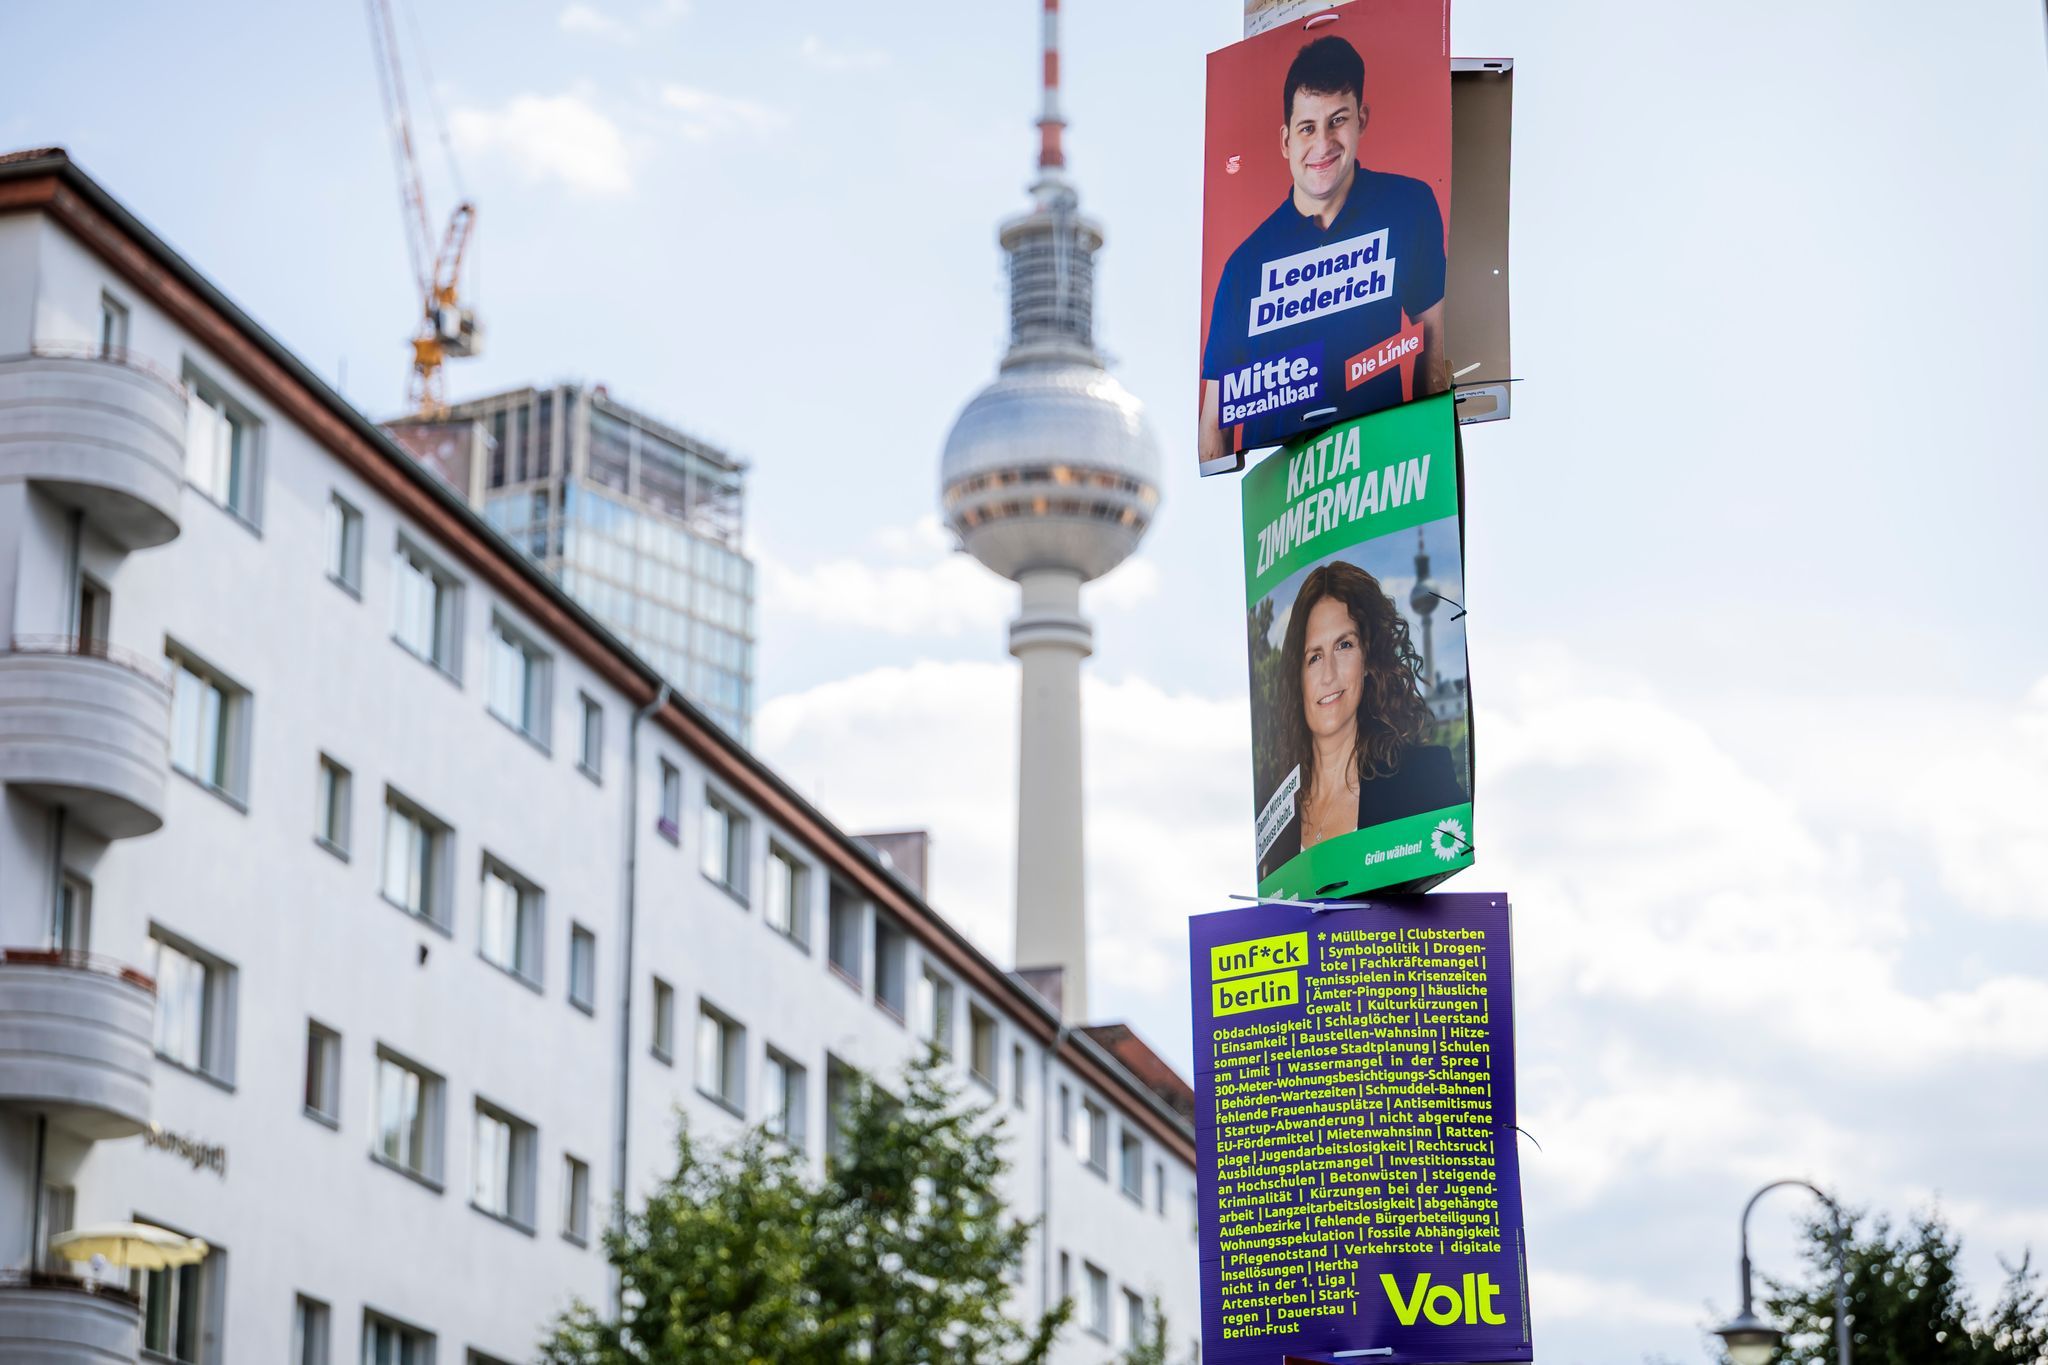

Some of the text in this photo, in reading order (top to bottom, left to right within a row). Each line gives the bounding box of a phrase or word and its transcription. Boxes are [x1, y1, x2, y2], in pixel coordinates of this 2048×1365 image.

[1269, 238, 1380, 291] Leonard
[1257, 270, 1385, 327] Diederich
[1351, 336, 1418, 381] Die Linke
[1224, 356, 1318, 403] Mitte.
[1223, 382, 1318, 424] Bezahlbar
[1286, 426, 1360, 504] KATJA
[1256, 454, 1431, 578] ZIMMERMANN
[1270, 794, 1281, 817] Mitte
[1365, 840, 1422, 866] Grün wählen!
[1331, 930, 1396, 943] Müllberge
[1407, 928, 1485, 939] Clubsterben
[1329, 942, 1420, 959] Symbolpolitik
[1434, 943, 1486, 955] Drogen-
[1321, 961, 1348, 972] tote
[1360, 956, 1479, 970] Fachkräftemangel
[1305, 970, 1486, 987] Tennisspielen in Krisenzeiten
[1220, 981, 1290, 1009] berlin
[1313, 985, 1417, 1000] Ämter-Pingpong
[1428, 984, 1487, 995] häusliche
[1306, 1001, 1351, 1015] Gewalt
[1368, 998, 1478, 1011] Kulturkürzungen
[1213, 1018, 1312, 1041] Obdachlosigkeit
[1325, 1013, 1410, 1027] Schlaglöcher
[1424, 1013, 1488, 1024] Leerstand
[1222, 1035, 1287, 1053] Einsamkeit
[1300, 1026, 1437, 1043] Baustellen-Wahnsinn
[1451, 1027, 1489, 1038] Hitze-
[1214, 1055, 1261, 1069] sommer
[1271, 1045, 1338, 1061] seelenlose
[1341, 1041, 1429, 1054] Stadtplanung
[1440, 1041, 1489, 1052] Schulen
[1215, 1073, 1232, 1082] am
[1240, 1066, 1270, 1079] Limit
[1288, 1055, 1383, 1073] Wassermangel
[1391, 1055, 1403, 1066] in
[1411, 1055, 1433, 1066] der
[1441, 1055, 1478, 1068] Spree
[1215, 1069, 1490, 1096] 300-Meter-Wohnungsbesichtigungs-Schlangen
[1222, 1086, 1356, 1109] Behörden-Wartezeiten
[1366, 1083, 1484, 1095] Schmuddel-Bahnen
[1216, 1108, 1268, 1124] fehlende
[1271, 1099, 1383, 1117] Frauenhausplätze
[1394, 1097, 1492, 1109] Antisemitismus
[1225, 1115, 1364, 1137] Startup-Abwanderung
[1380, 1111, 1413, 1123] nicht
[1418, 1111, 1492, 1125] abgerufene
[1217, 1130, 1314, 1152] EU-Fördermittel
[1327, 1125, 1432, 1140] Mietenwahnsinn
[1446, 1127, 1493, 1137] Ratten-
[1218, 1155, 1250, 1169] plage
[1259, 1140, 1406, 1162] Jugendarbeitslosigkeit
[1417, 1140, 1487, 1151] Rechtsruck
[1218, 1155, 1373, 1181] Ausbildungsplatzmangel
[1390, 1154, 1495, 1166] Investitionsstau
[1218, 1186, 1232, 1195] an
[1237, 1175, 1315, 1192] Hochschulen
[1330, 1169, 1417, 1183] Betonwüsten
[1432, 1169, 1496, 1182] steigende
[1219, 1191, 1292, 1209] Kriminalität
[1311, 1186, 1380, 1199] Kürzungen
[1388, 1183, 1409, 1194] bei
[1416, 1183, 1438, 1194] der
[1444, 1183, 1497, 1196] Jugend-
[1219, 1209, 1254, 1223] arbeit
[1265, 1197, 1415, 1218] Langzeitarbeitslosigkeit
[1425, 1197, 1498, 1211] abgehängte
[1220, 1219, 1301, 1237] Außenbezirke
[1315, 1213, 1370, 1227] fehlende
[1376, 1211, 1490, 1225] Bürgerbeteiligung
[1220, 1229, 1354, 1251] Wohnungsspekulation
[1368, 1226, 1411, 1238] fossile
[1415, 1226, 1500, 1239] Abhängigkeit
[1231, 1245, 1327, 1266] Pflegenotstand
[1344, 1242, 1433, 1254] Verkehrstote
[1451, 1241, 1501, 1254] digitale
[1222, 1265, 1304, 1281] Insellösungen
[1315, 1258, 1358, 1271] Hertha
[1222, 1282, 1253, 1295] nicht
[1258, 1281, 1269, 1291] in
[1275, 1278, 1296, 1290] der
[1302, 1277, 1312, 1287] 1.
[1318, 1274, 1345, 1287] Liga
[1222, 1293, 1307, 1310] Artensterben
[1319, 1287, 1359, 1300] Stark-
[1379, 1273, 1506, 1326] Volt
[1223, 1313, 1258, 1325] regen
[1278, 1305, 1344, 1319] Dauerstau
[1224, 1322, 1299, 1339] Berlin-Frust
